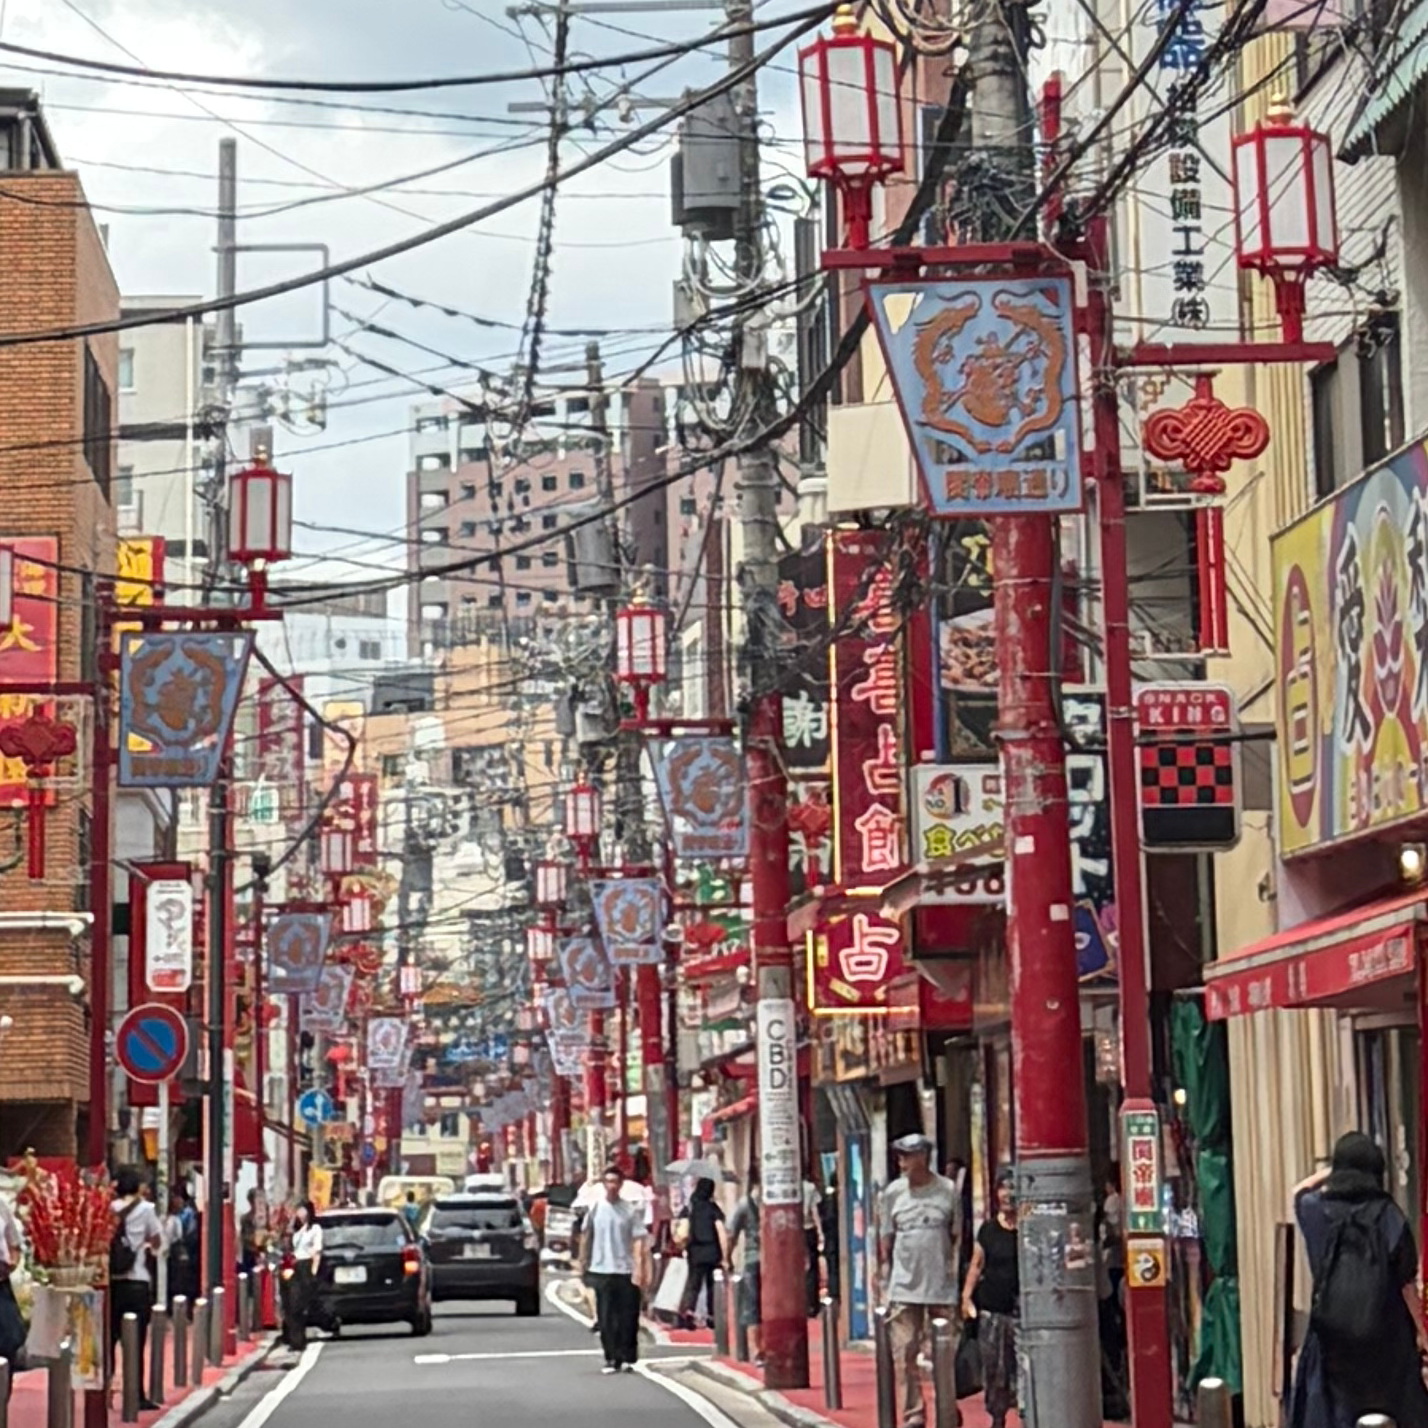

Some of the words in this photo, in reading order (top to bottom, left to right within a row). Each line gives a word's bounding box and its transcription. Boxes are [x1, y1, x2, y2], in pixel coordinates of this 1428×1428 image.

[1143, 693, 1219, 705] SNACK
[1148, 705, 1226, 724] KING
[838, 912, 900, 982] 占
